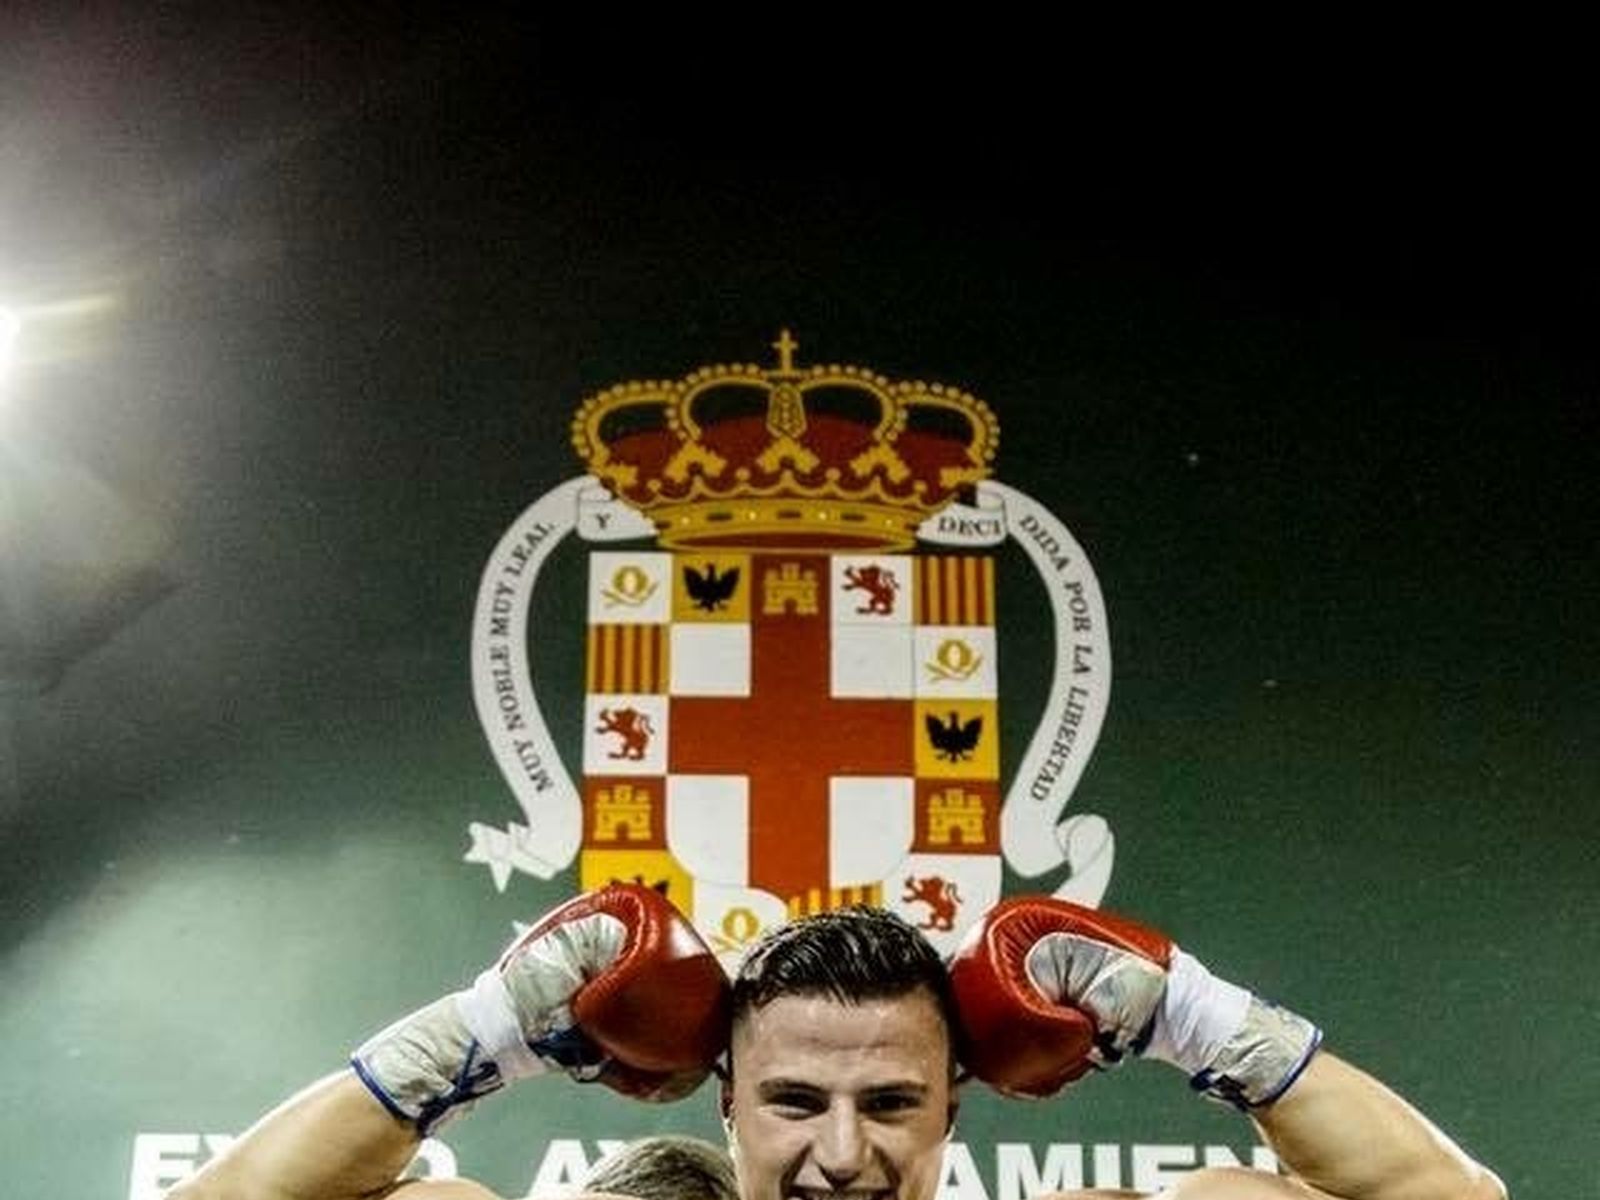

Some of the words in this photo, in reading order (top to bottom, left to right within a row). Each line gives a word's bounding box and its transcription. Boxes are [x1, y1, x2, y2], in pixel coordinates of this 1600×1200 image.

[505, 520, 555, 576] LEAL
[937, 516, 1001, 536] DECI
[1018, 514, 1071, 574] DIDA
[490, 582, 517, 637] MUY
[1065, 582, 1094, 634] POR
[1072, 642, 1094, 677] LA
[489, 642, 527, 734] NOBLE
[513, 738, 554, 793] MUY
[1031, 684, 1088, 802] LIBERTAD
